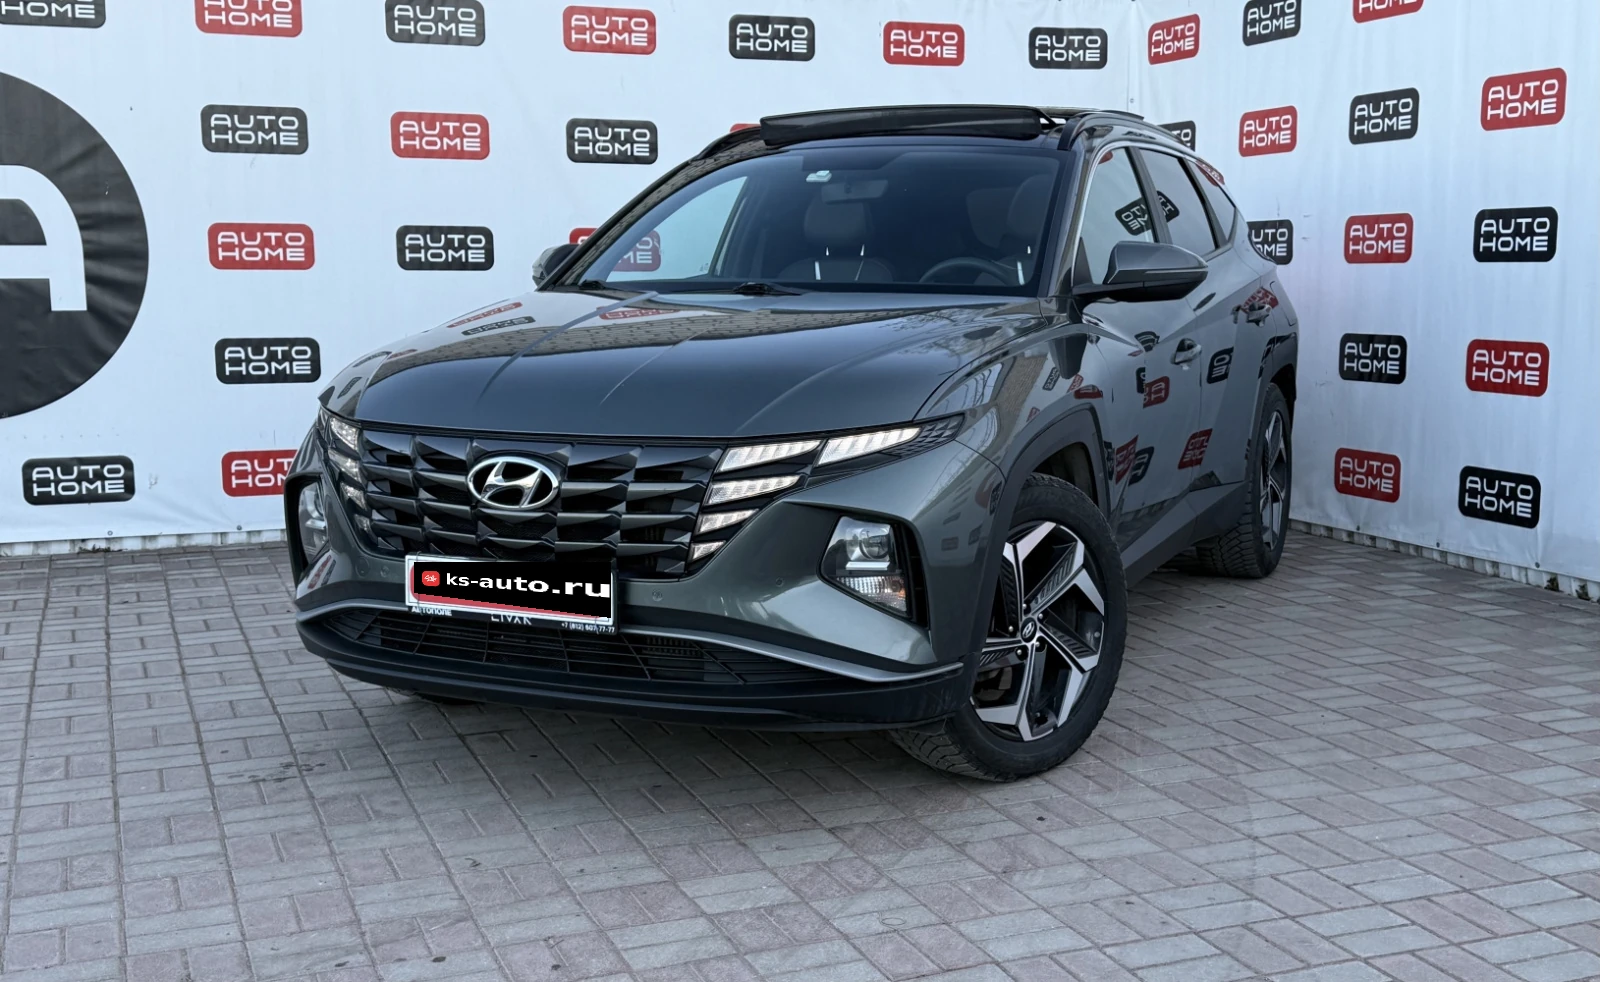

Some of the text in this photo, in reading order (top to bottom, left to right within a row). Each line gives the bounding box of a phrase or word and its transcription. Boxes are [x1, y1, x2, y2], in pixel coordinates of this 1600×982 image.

[1, 1, 95, 18] HOME
[394, 5, 476, 21] AUTO
[1248, 0, 1296, 22] AUTO
[205, 10, 292, 28] HOME
[572, 15, 648, 31] AUTO
[1247, 14, 1295, 36] HOME
[395, 20, 476, 37] HOME
[737, 23, 808, 38] AUTO
[1152, 23, 1195, 42] AUTO
[572, 30, 647, 46] HOME
[737, 38, 807, 52] HOME
[891, 30, 958, 44] AUTO
[1036, 35, 1101, 47] AUTO
[891, 44, 957, 58] HOME
[1152, 37, 1194, 56] HOME
[1036, 49, 1100, 61] HOME
[1488, 79, 1558, 102] AUTO
[1355, 98, 1412, 118] AUTO
[1488, 98, 1556, 120] HOME
[211, 114, 298, 130] AUTO
[400, 121, 480, 136] AUTO
[1244, 115, 1292, 133] AUTO
[1354, 115, 1411, 135] HOME
[211, 130, 298, 145] HOME
[575, 127, 650, 141] AUTO
[1244, 130, 1291, 148] HOME
[400, 136, 480, 151] HOME
[575, 142, 649, 156] HOME
[1350, 223, 1407, 238] AUTO
[1481, 218, 1550, 234] AUTO
[218, 232, 305, 246] AUTO
[405, 234, 485, 247] AUTO
[1252, 228, 1288, 242] UTO
[1350, 240, 1405, 254] HOME
[1480, 236, 1548, 252] HOME
[218, 248, 304, 260] HOME
[406, 249, 485, 262] HOME
[225, 346, 311, 360] AUTO
[1345, 342, 1400, 358] AUTO
[1344, 358, 1399, 374] HOME
[1474, 350, 1541, 368] AUTO
[226, 361, 311, 375] HOME
[1472, 367, 1539, 386] HOME
[32, 464, 124, 480] AUTO
[231, 458, 294, 473] AUT
[1340, 457, 1394, 476] AUTO
[33, 480, 124, 496] HOME
[231, 473, 286, 488] HO
[1340, 472, 1393, 493] HOME
[1466, 476, 1533, 500] AUTO
[1465, 493, 1532, 518] HOME
